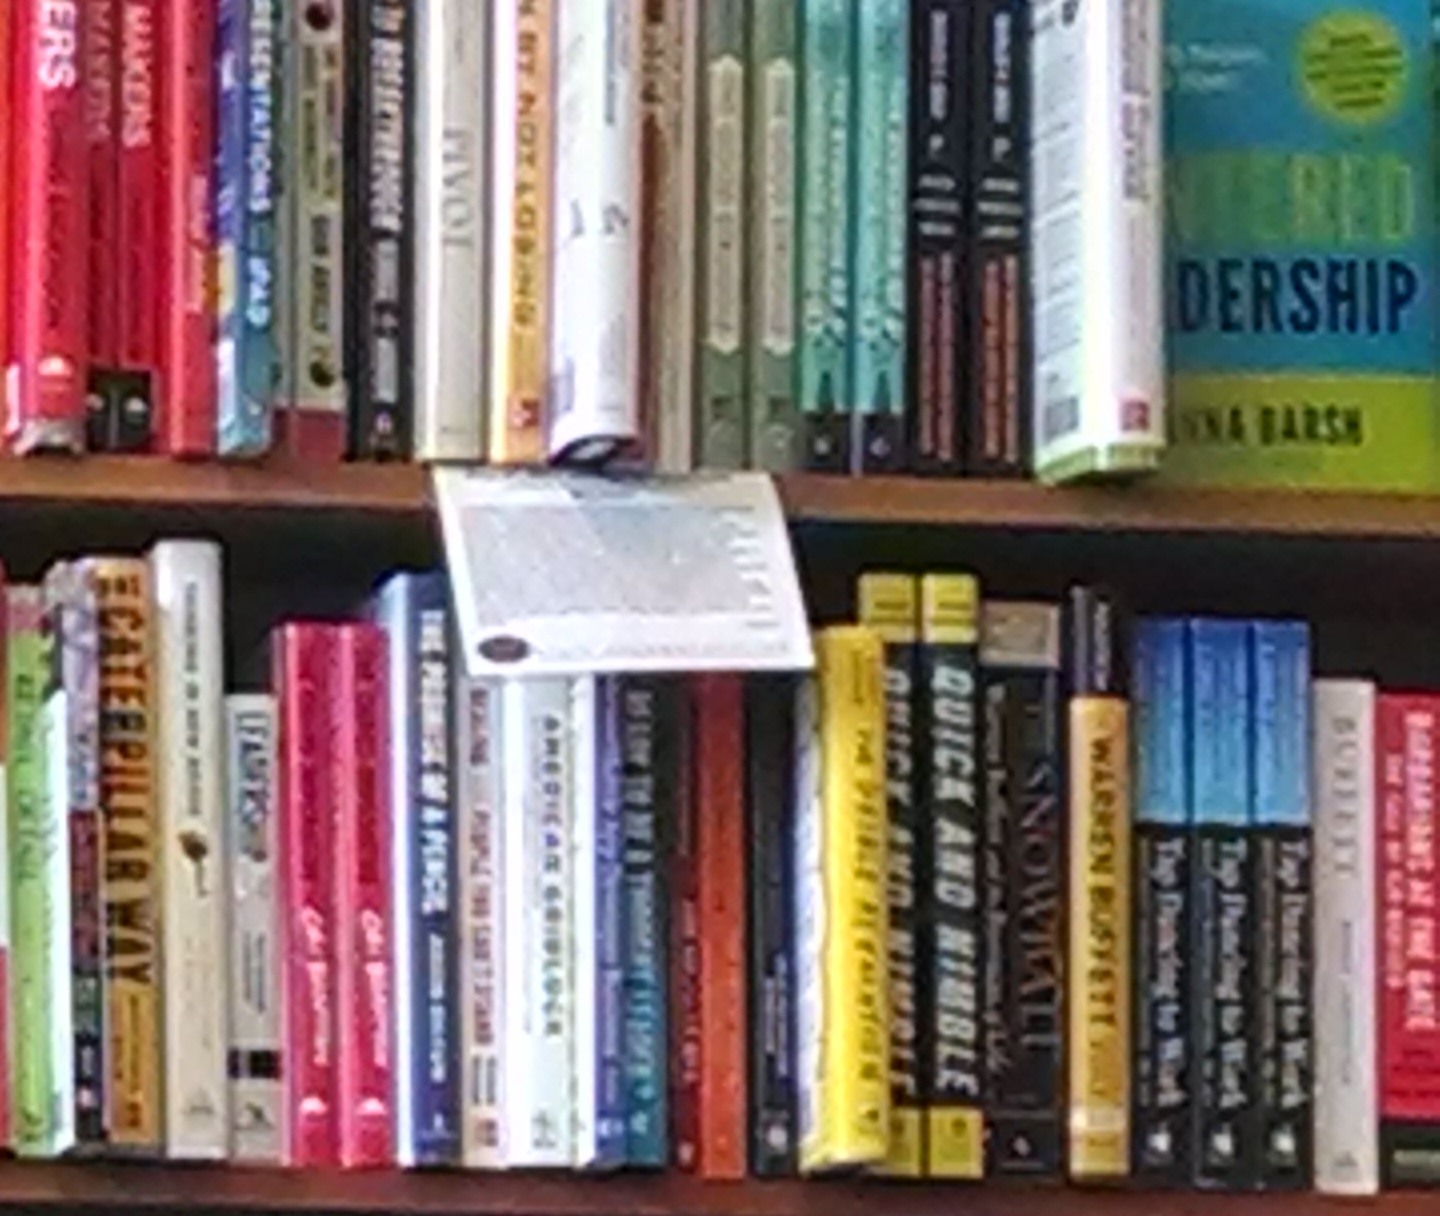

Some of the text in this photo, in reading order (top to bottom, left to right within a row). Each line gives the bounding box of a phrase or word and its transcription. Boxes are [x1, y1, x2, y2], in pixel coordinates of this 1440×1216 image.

[99, 605, 152, 986] CATERPILLAR WAY
[543, 715, 563, 875] AMERICAN
[932, 665, 977, 1094] QUICK AND NIMBLE
[1088, 737, 1116, 1027] WARREN BUFFETT
